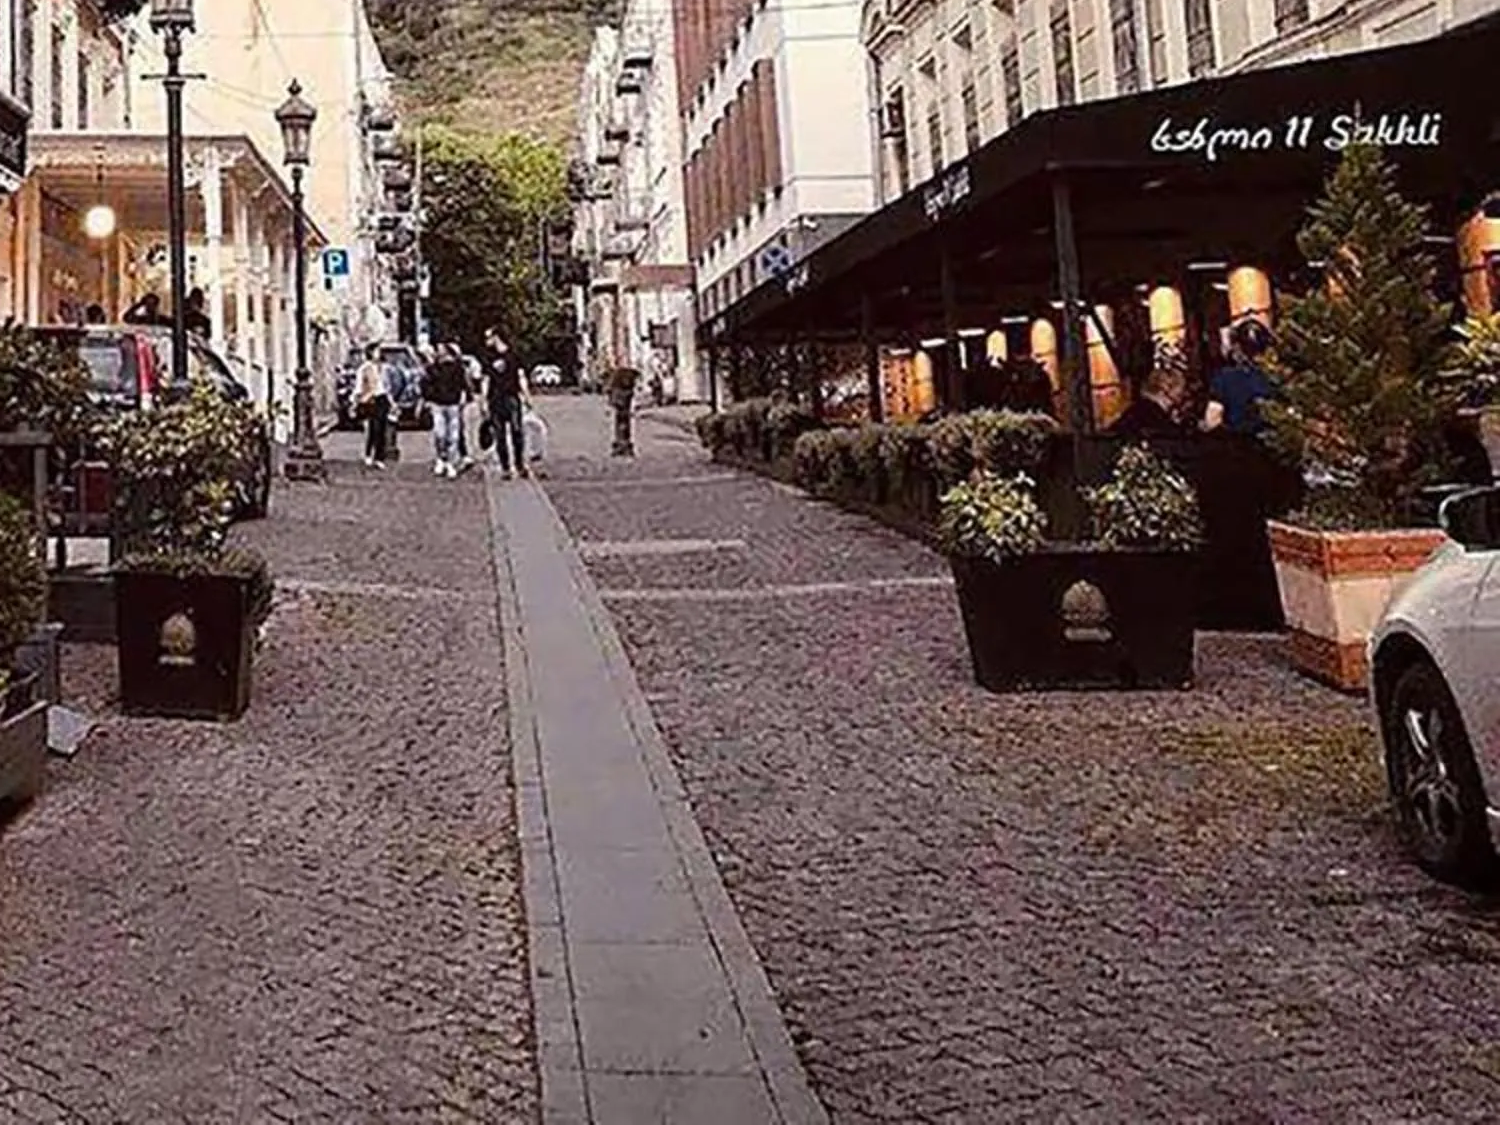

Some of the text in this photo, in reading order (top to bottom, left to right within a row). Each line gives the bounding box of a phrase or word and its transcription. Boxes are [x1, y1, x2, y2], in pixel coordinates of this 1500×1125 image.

[1285, 115, 1314, 148] 11
[1323, 113, 1442, 151] Sakhli
[328, 252, 344, 274] P
